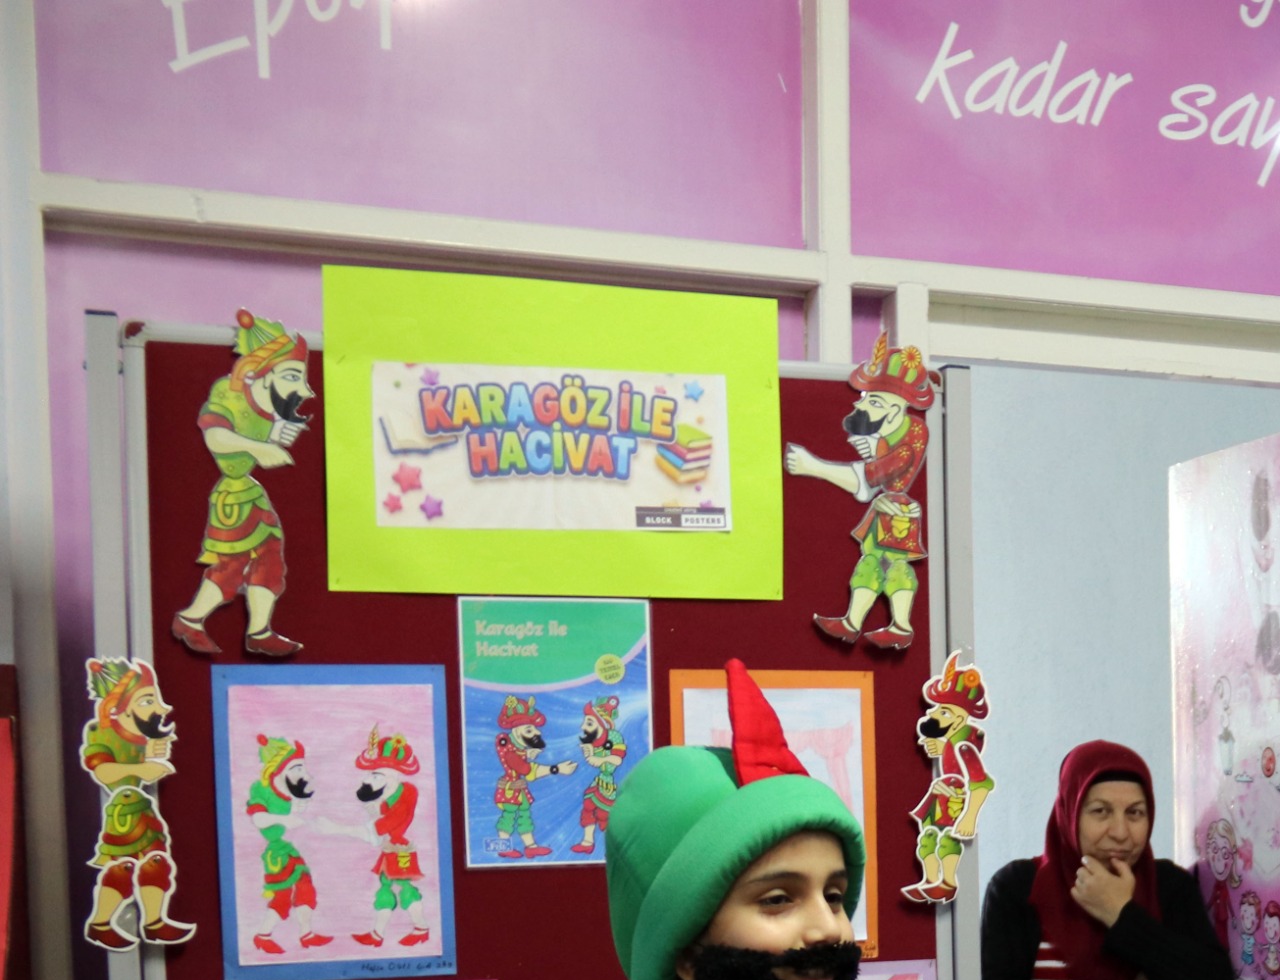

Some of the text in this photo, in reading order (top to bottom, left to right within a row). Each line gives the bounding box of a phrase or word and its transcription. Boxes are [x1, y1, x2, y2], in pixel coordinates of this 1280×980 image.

[915, 22, 1133, 127] kadar
[419, 375, 677, 442] KARAGÖZ İLE
[467, 422, 637, 479] HACİVAT
[645, 516, 721, 525] BLOCK POSTERS
[475, 620, 544, 639] Karagöz
